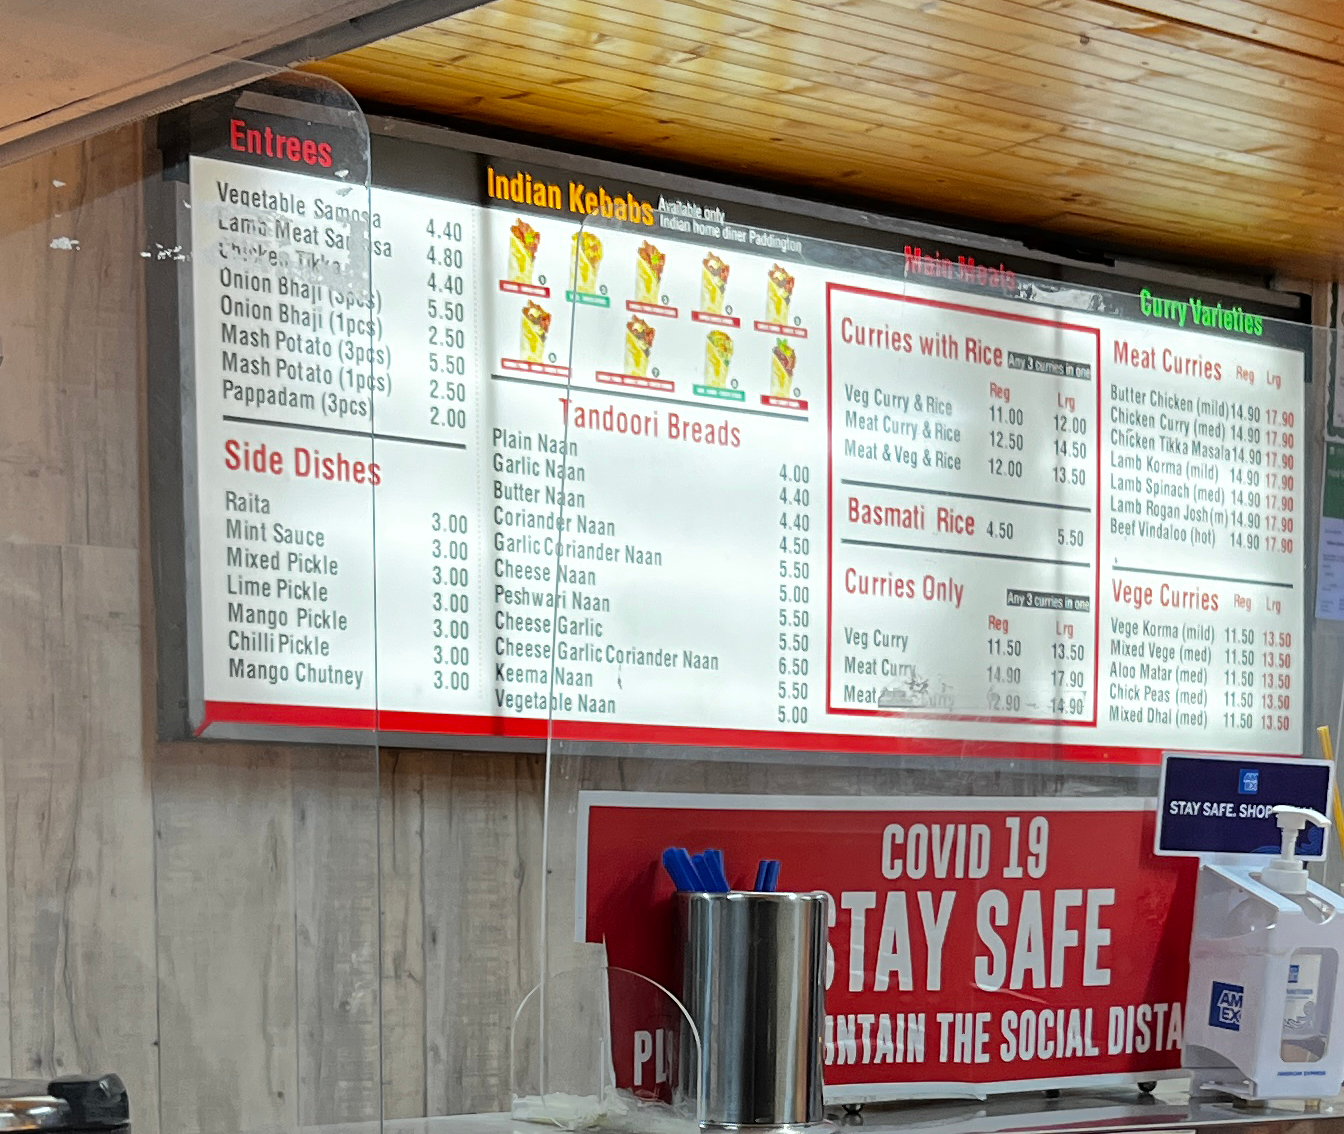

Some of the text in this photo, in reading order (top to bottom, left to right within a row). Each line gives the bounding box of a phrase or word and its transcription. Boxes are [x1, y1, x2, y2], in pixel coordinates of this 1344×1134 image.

[230, 119, 332, 168] Entrees
[487, 166, 654, 226] Indian Kebabs
[658, 194, 725, 223] Available only
[659, 214, 802, 253] Indian home diner Paddington
[904, 245, 1016, 291] Main Meals
[1140, 288, 1263, 335] Curry Varieties
[222, 323, 465, 375] Mash Potato (3pcs) 5.50
[842, 317, 912, 353] Curries
[920, 333, 958, 360] with
[966, 338, 1002, 367] Rice
[1114, 340, 1281, 389] Meat Curries Reg Lrg
[223, 351, 465, 402] Mash Potato (1pcs) 2.50
[223, 380, 465, 428] Pappadam (3pcs) 2.00
[559, 398, 741, 448] Tandoori Breads
[845, 384, 1086, 434] Veg Curry & Rice 11.00 12.00
[1111, 384, 1294, 427] Butter Chicken (mild) 14.90 17.90
[225, 439, 381, 486] Side Dishes
[493, 428, 809, 483] Plain Naan 4.00
[494, 453, 809, 506] Garlic Naan 4.40
[226, 491, 467, 534] Raita 3.00
[494, 506, 809, 556] Coriander Naan 4.50
[849, 497, 1083, 547] Basmati Rice 4.50 5.50
[226, 519, 467, 561] Mint Sauce 3.00
[227, 547, 468, 587] Mixed Pickle 3.00
[845, 568, 964, 608] Curries Only
[1112, 578, 1218, 611] Vege Curries
[1110, 705, 1289, 730] Mixed Dhal (med) 11.50 13.50
[1170, 800, 1273, 818] STAY SAFE. SHOP
[881, 816, 1049, 881] COVID 19
[974, 887, 1115, 993] SAFE
[937, 1014, 994, 1063] THE
[1000, 1008, 1100, 1061] SOCIAL
